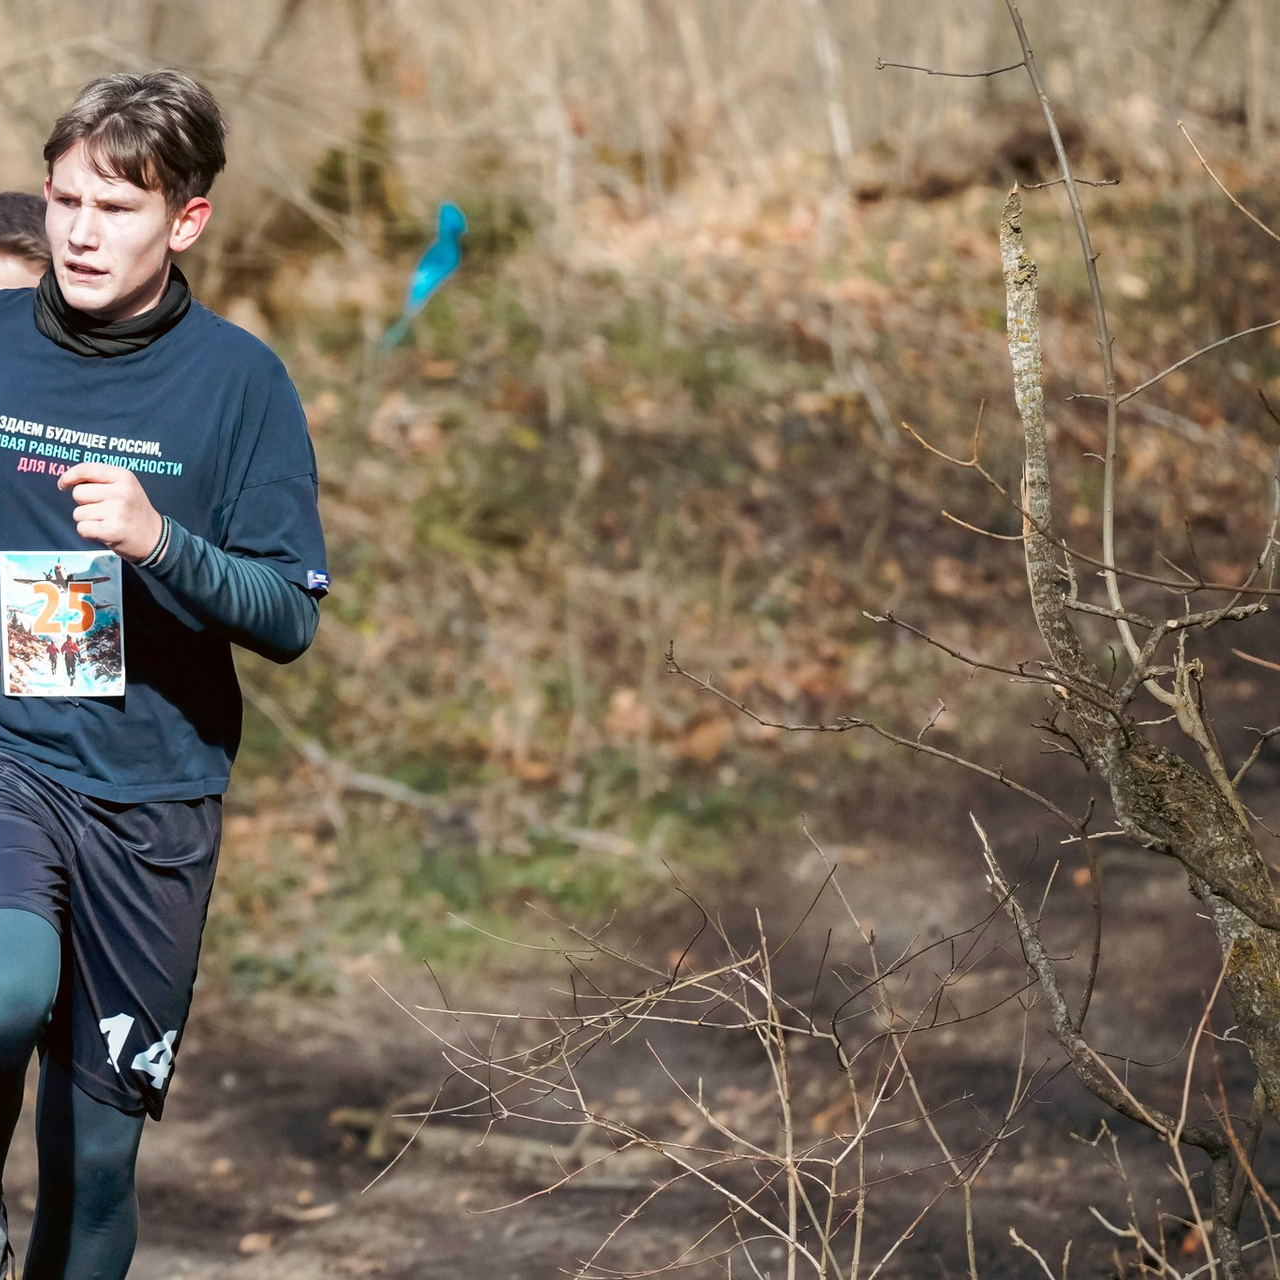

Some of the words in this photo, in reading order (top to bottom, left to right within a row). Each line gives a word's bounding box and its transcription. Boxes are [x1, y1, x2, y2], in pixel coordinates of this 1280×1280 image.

[28, 440, 81, 462] РАВНЫЕ
[83, 451, 183, 476] ВОЗМОЖНОСТИ
[45, 425, 106, 449] БУДУЩЕЕ
[108, 436, 162, 457] РОССИИ,
[17, 457, 46, 473] ДЛЯ
[32, 582, 95, 634] 25
[99, 1012, 178, 1090] 14
